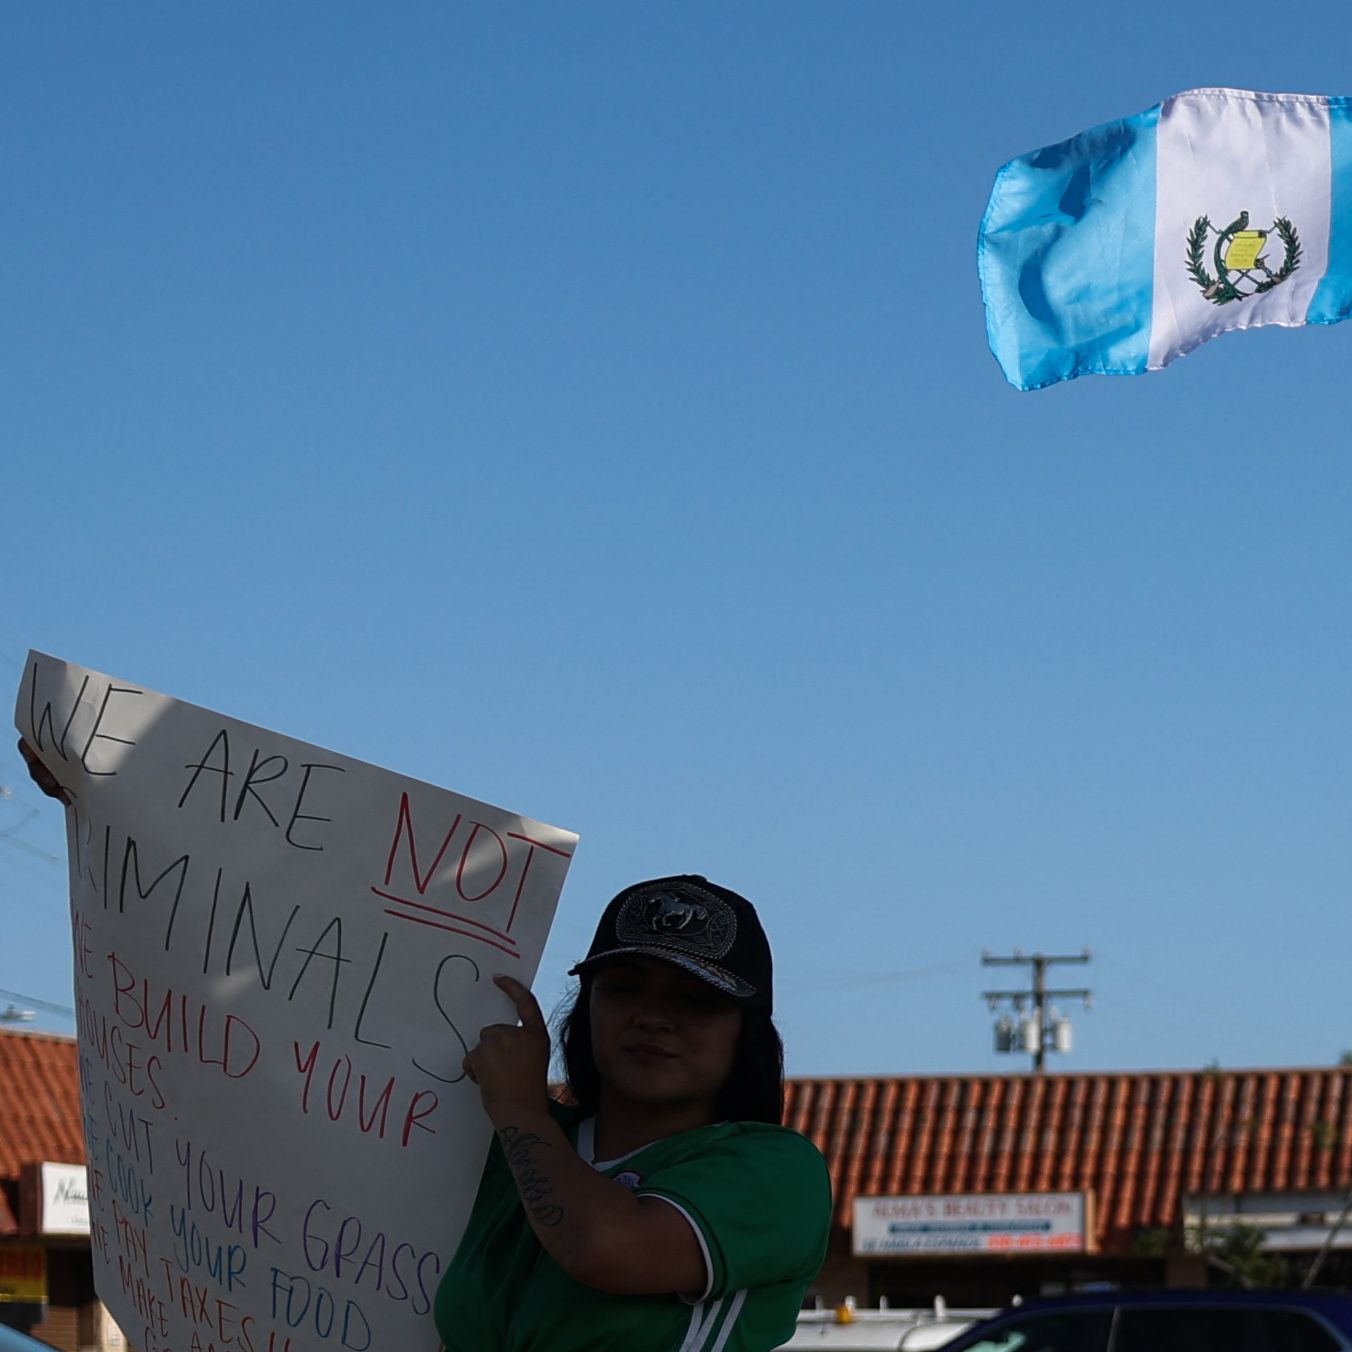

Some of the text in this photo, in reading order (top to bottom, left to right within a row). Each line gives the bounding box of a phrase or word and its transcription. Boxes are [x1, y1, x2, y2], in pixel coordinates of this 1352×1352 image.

[33, 662, 572, 934] WE ARE NOT
[72, 802, 480, 1084] RIMINALS
[107, 951, 261, 1080] BUILD
[293, 1040, 440, 1148] YOUR
[104, 1079, 154, 1176] CUT
[175, 1137, 283, 1250] YOUR
[303, 1198, 441, 1317] GRASS
[105, 1137, 154, 1228] COOK
[170, 1203, 248, 1293] YOUR
[270, 1266, 372, 1352] FOOD
[112, 1198, 150, 1279] PAY
[118, 1254, 169, 1339] MAKE
